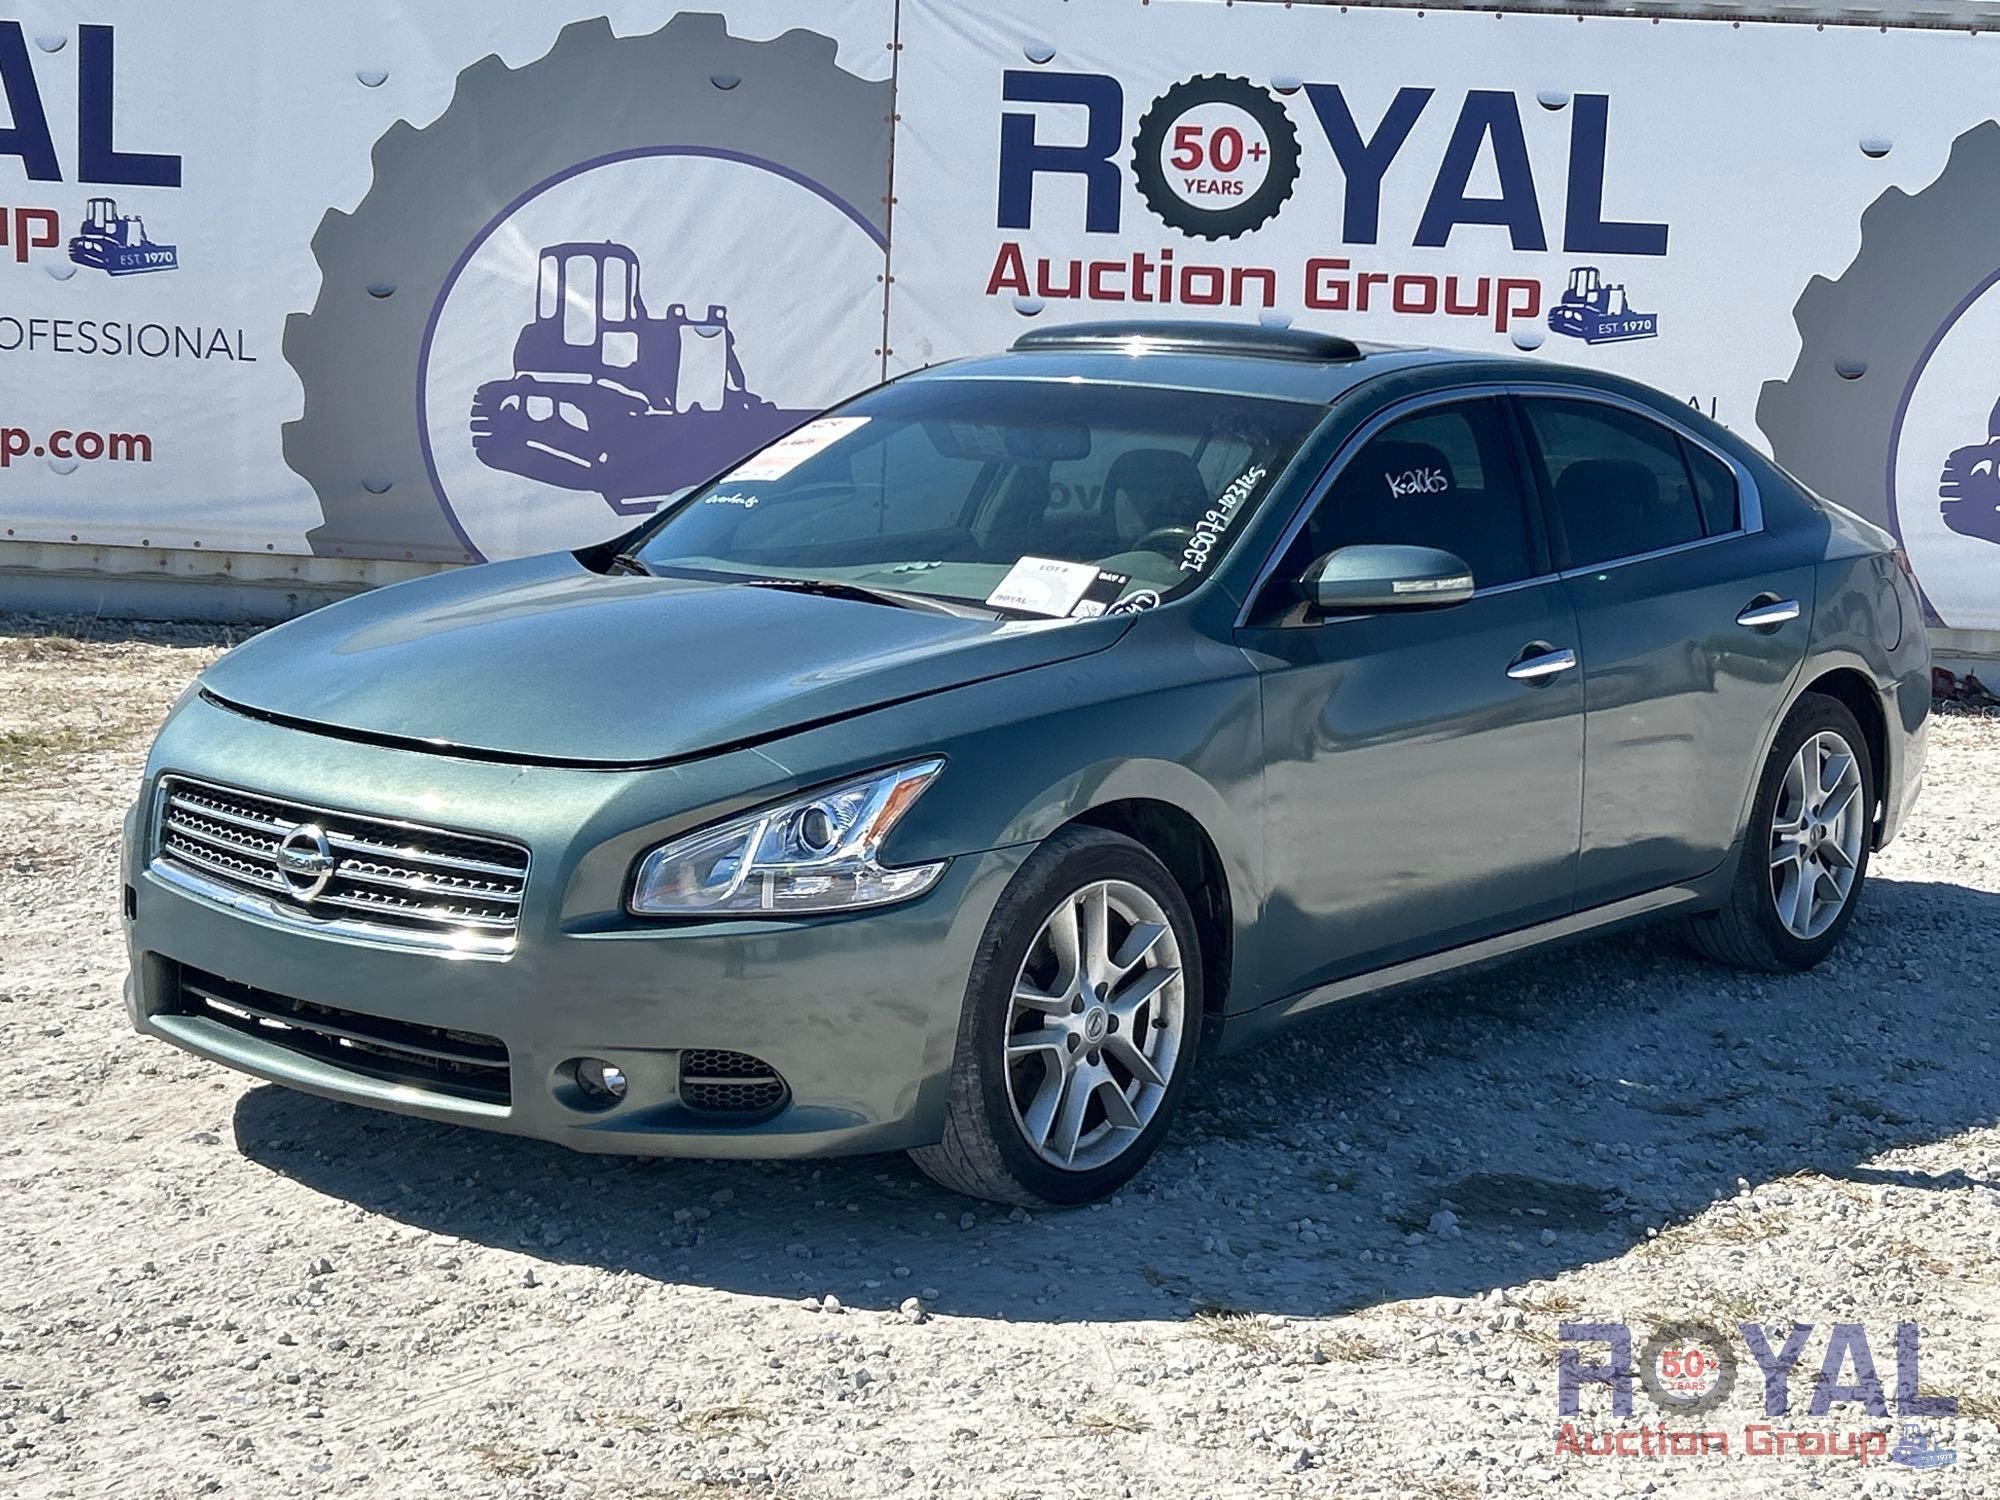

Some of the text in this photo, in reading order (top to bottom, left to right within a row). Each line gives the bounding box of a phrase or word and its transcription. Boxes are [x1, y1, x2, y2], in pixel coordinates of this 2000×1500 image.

[997, 69, 1669, 255] ROYAL
[1170, 125, 1267, 173] 50+
[1184, 178, 1244, 196] YEARS
[144, 251, 173, 263] 1970
[986, 242, 1542, 333] Auction Group
[0, 316, 257, 362] OFESSIONAL
[1622, 319, 1652, 332] 1970
